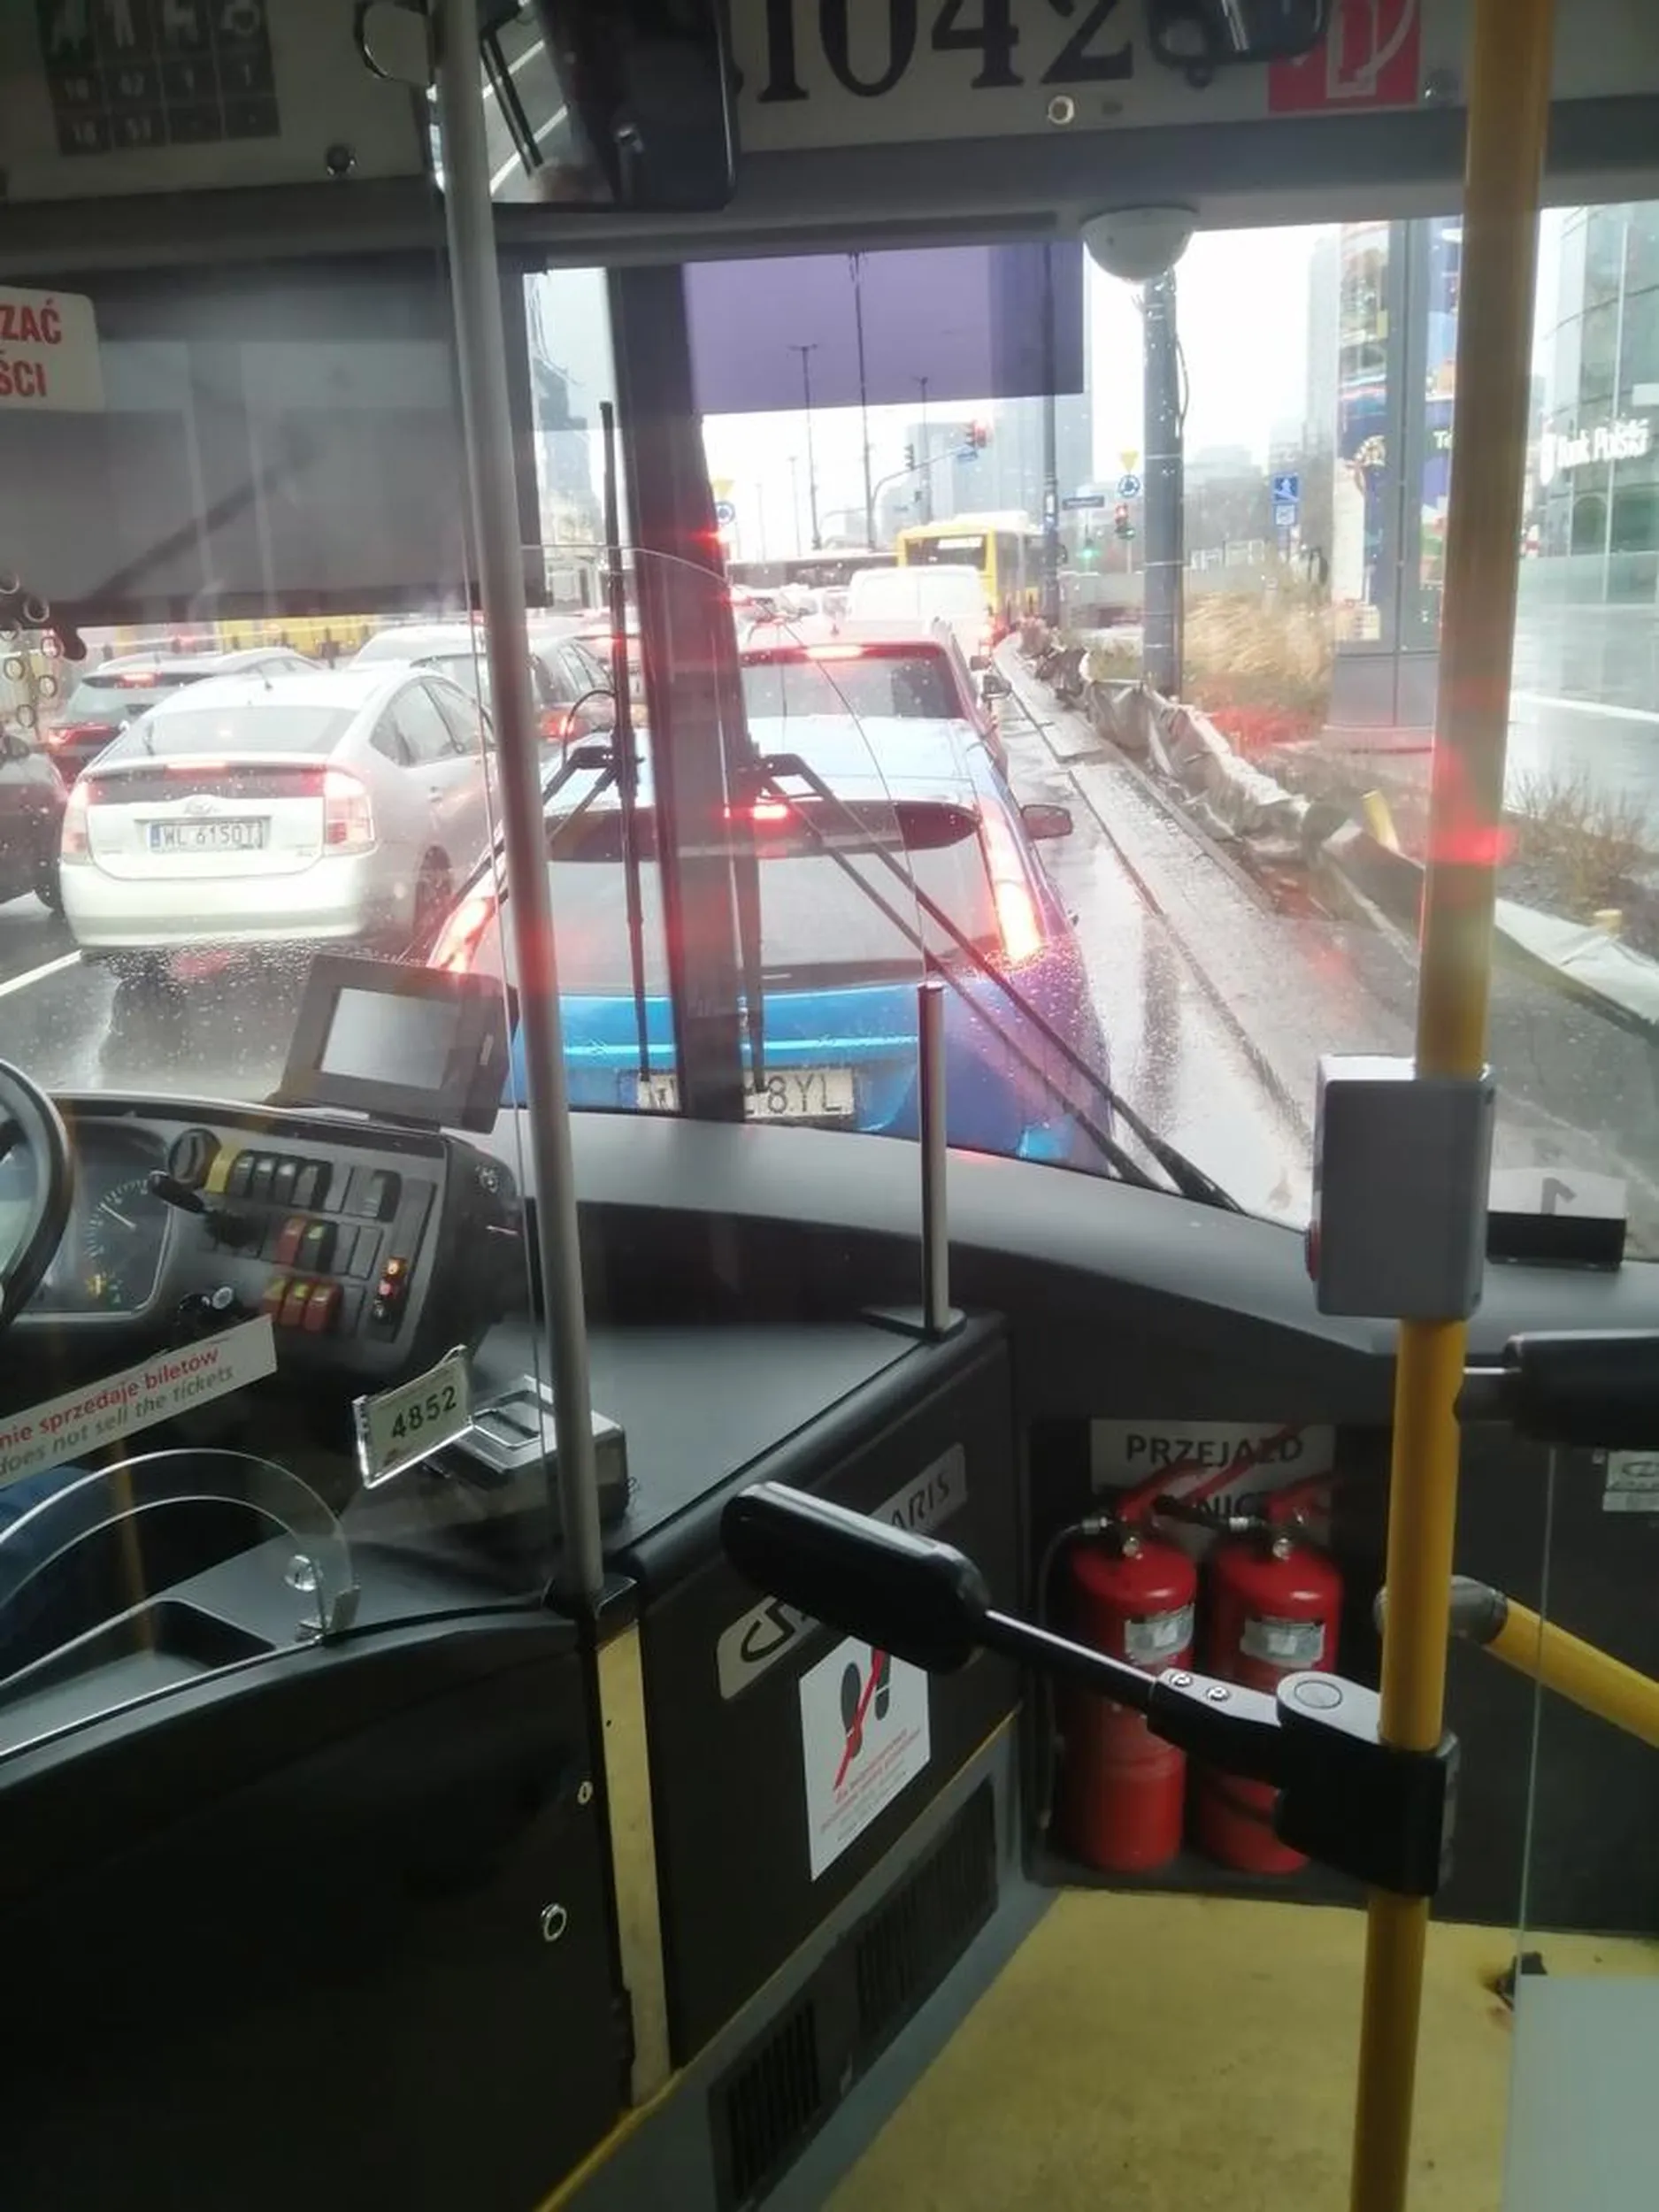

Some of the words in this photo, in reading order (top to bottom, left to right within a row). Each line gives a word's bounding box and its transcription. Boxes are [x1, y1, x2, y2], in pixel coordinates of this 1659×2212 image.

[0, 296, 61, 344] ZAĆ
[164, 825, 188, 847] WL
[0, 1422, 33, 1448] nie
[39, 1381, 139, 1434] sprzedaje
[0, 1444, 44, 1475] does
[53, 1425, 93, 1452] not
[96, 1407, 128, 1432] sell
[135, 1394, 167, 1420] the
[173, 1365, 234, 1402] tickets
[390, 1386, 457, 1438] 4852
